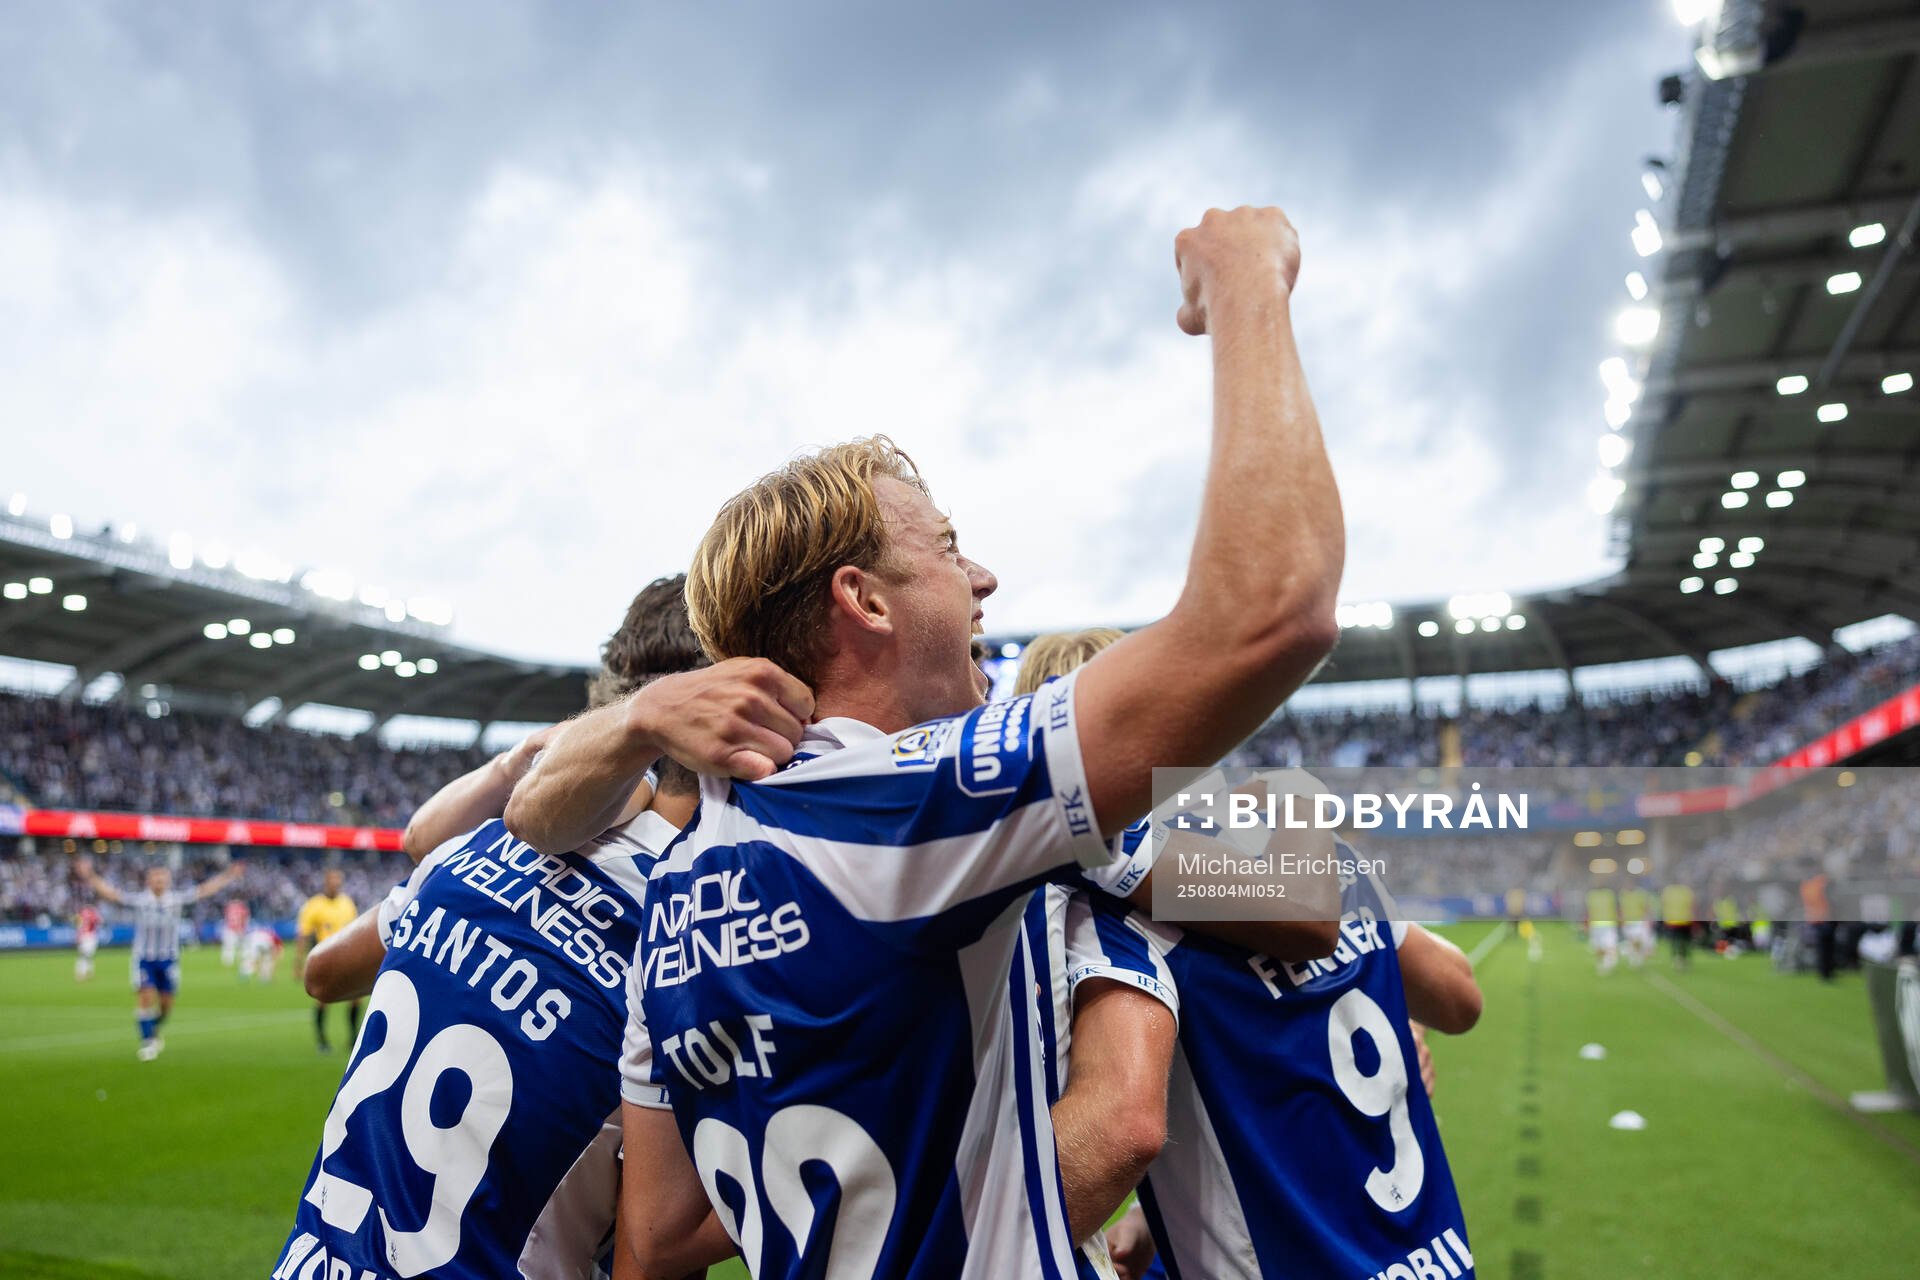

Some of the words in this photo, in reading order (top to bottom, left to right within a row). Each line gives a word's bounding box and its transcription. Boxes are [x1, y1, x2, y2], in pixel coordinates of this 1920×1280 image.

[973, 699, 1016, 782] UNIB
[1051, 685, 1069, 732] IFK
[1060, 785, 1092, 837] IFK
[443, 848, 630, 989] WELLNESS
[486, 832, 625, 930] NORDIC
[1116, 863, 1146, 893] IFK
[392, 900, 572, 1041] SANTOS
[1136, 974, 1167, 999] IFK
[661, 1014, 777, 1090] TOLF
[304, 970, 513, 1278] 29
[1328, 988, 1424, 1213] 9
